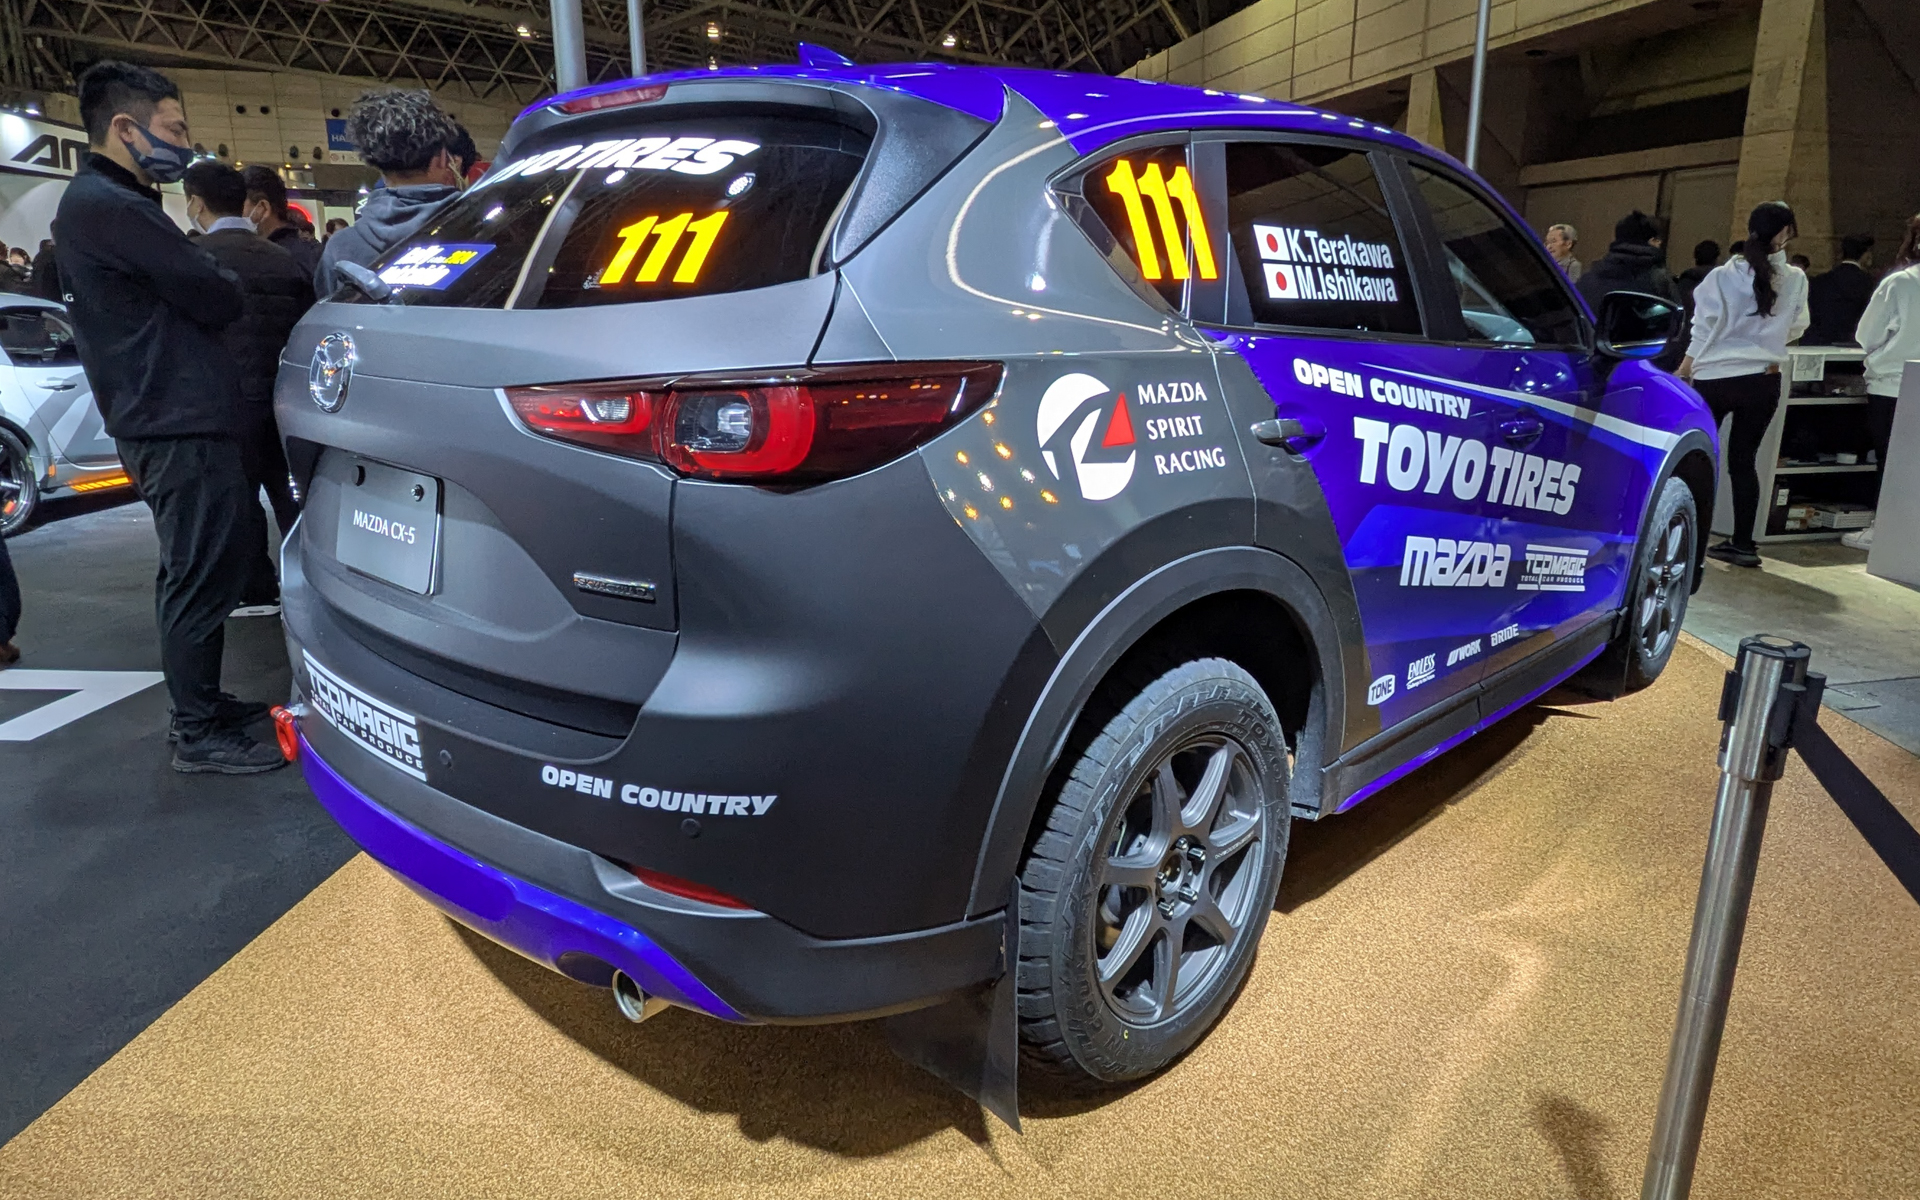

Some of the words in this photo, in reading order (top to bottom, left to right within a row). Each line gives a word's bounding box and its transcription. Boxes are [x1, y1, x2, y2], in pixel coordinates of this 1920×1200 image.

[1106, 159, 1218, 280] 111
[599, 211, 730, 284] 111
[1285, 227, 1395, 269] K.Terakawa
[1295, 265, 1399, 303] M.Ishikawa
[1137, 381, 1208, 405] MAZDA
[1292, 358, 1364, 398] OPEN
[1369, 377, 1471, 420] COUNTRY
[1146, 415, 1203, 440] SPIRIT
[1154, 447, 1226, 475] RACING
[353, 509, 389, 537] MAZDA
[390, 522, 416, 545] CX-5
[1458, 638, 1482, 662] WORK
[1490, 623, 1520, 647] BRIDE
[1407, 652, 1436, 680] ENDLESS
[1371, 677, 1393, 702] TONE
[310, 689, 331, 714] TOTAL
[336, 713, 356, 732] CAR
[361, 730, 424, 770] PRODUCE
[541, 765, 614, 799] OPEN
[620, 783, 779, 816] COUNTRY
